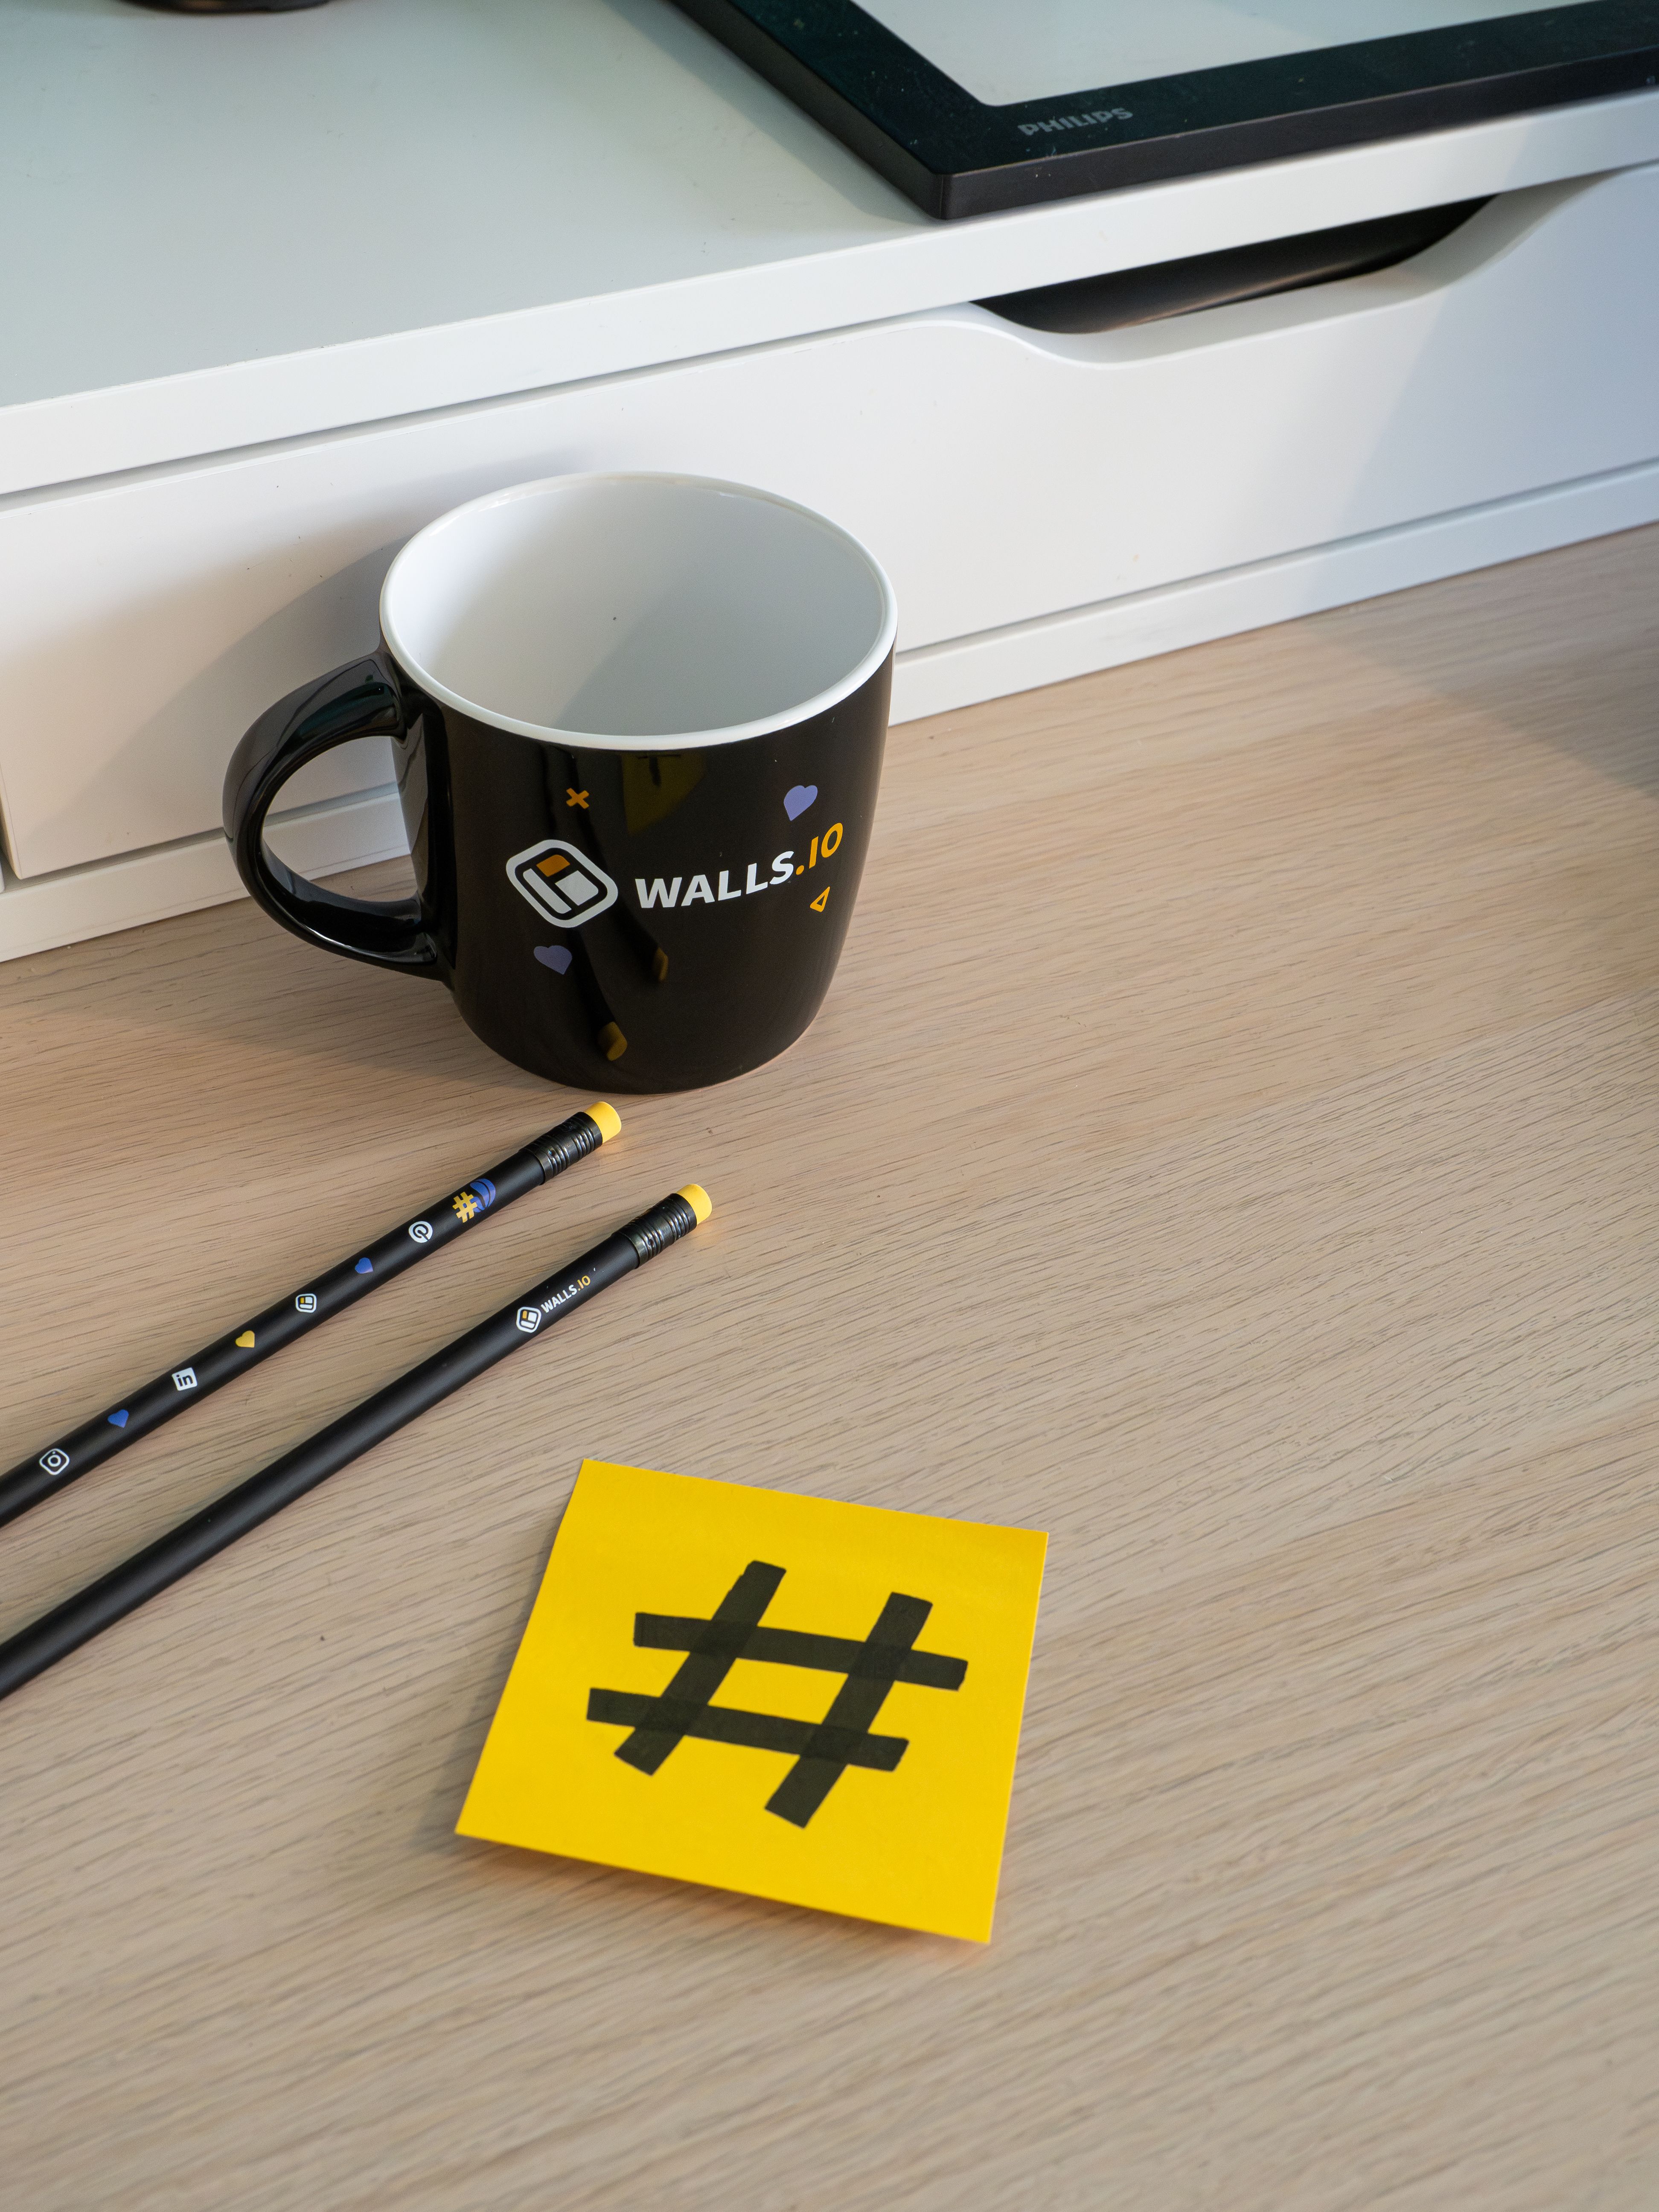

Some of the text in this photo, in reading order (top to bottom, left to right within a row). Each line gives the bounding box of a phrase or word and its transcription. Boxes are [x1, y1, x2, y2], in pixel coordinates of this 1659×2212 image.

[1017, 107, 1133, 136] PHILIPS
[635, 823, 843, 908] WALLS.IO
[540, 1275, 591, 1313] WALLS.IO
[586, 1560, 968, 1829] #
